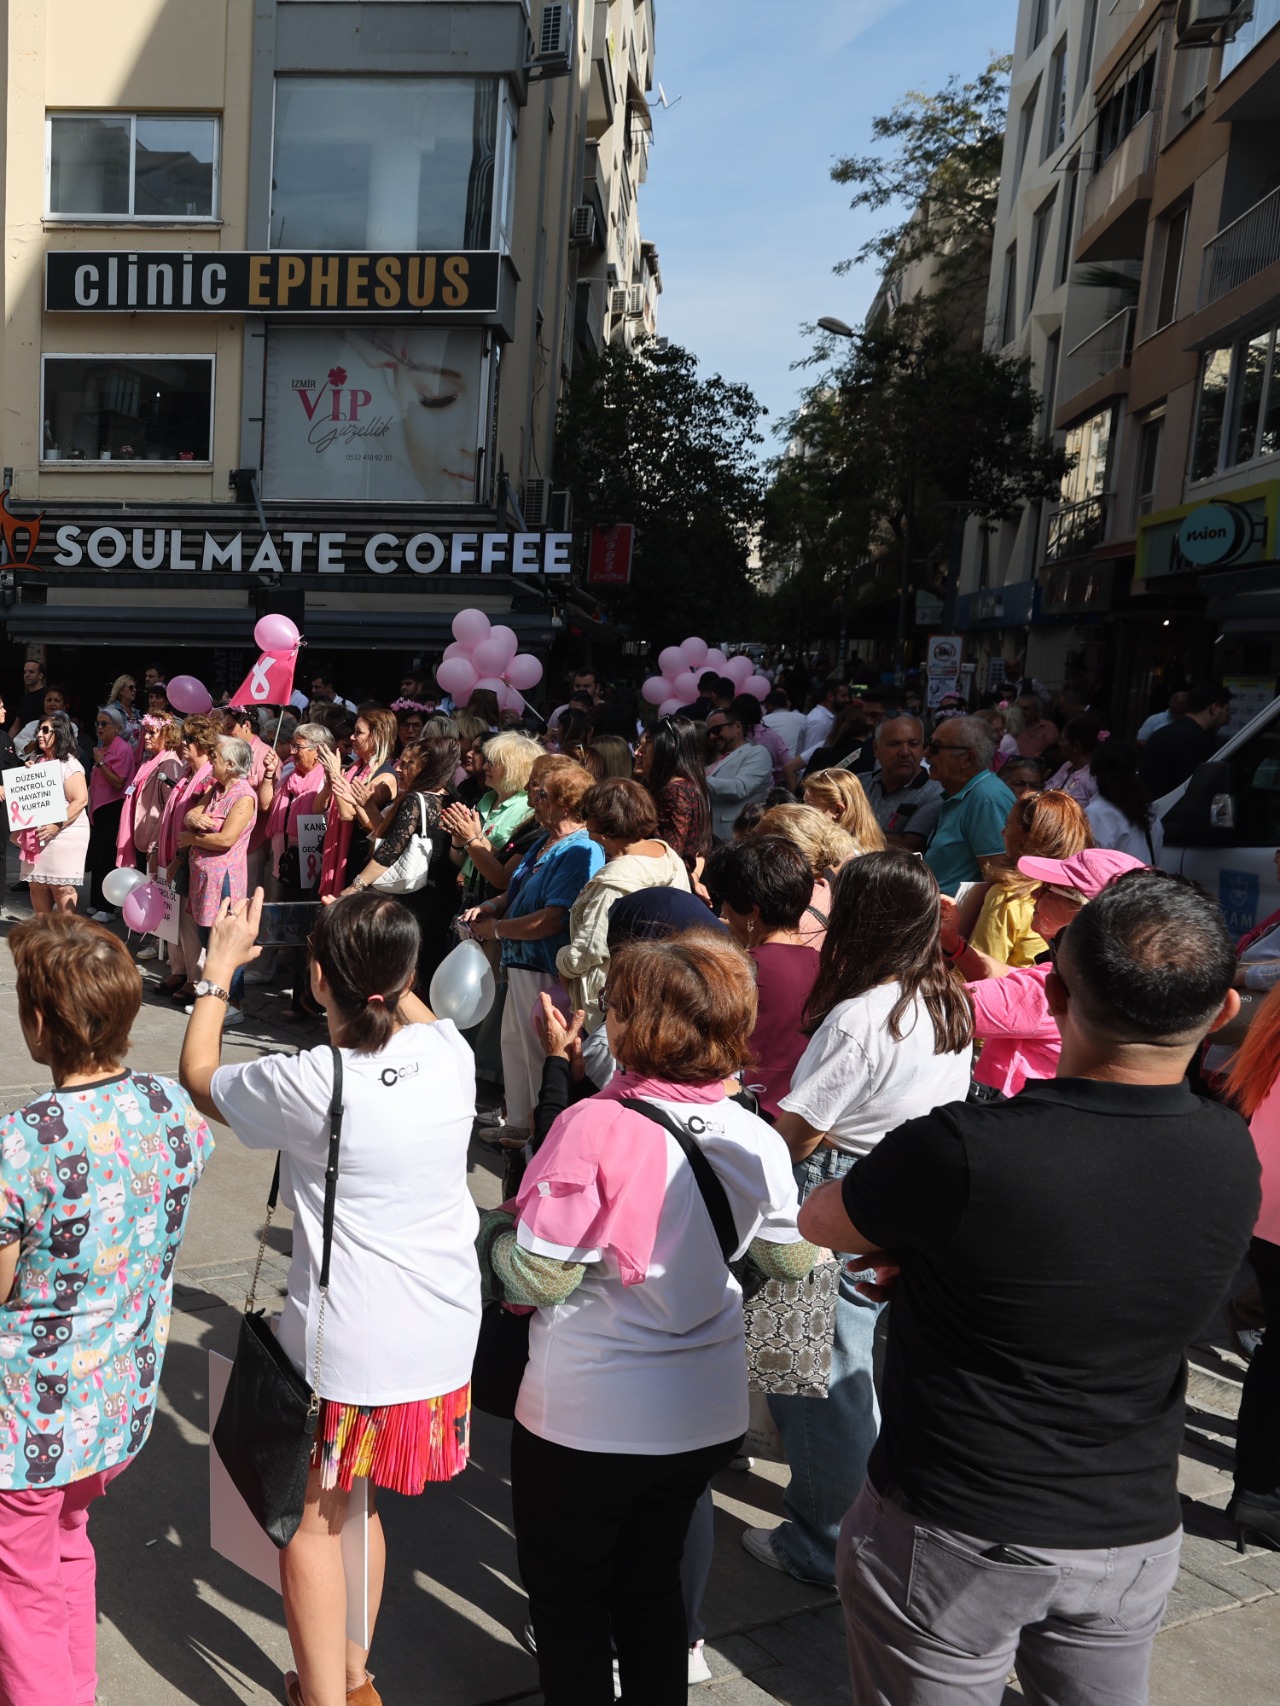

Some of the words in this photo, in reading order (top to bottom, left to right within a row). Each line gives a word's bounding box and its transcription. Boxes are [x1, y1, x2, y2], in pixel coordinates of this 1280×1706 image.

[75, 254, 227, 306] clinic
[249, 255, 470, 307] EPHESUS
[291, 377, 317, 389] İZMİR
[308, 412, 395, 454] Güzellik
[345, 454, 361, 462] 0532
[362, 454, 374, 462] 410
[375, 454, 383, 462] 92
[384, 454, 392, 462] 30
[1186, 526, 1227, 543] mion
[53, 526, 347, 575] SOULMATE
[364, 531, 573, 575] COFFEE
[10, 781, 45, 794] KONTROL
[46, 779, 57, 787] OL
[18, 790, 51, 803] HAYATINI
[21, 800, 51, 812] KURTAR
